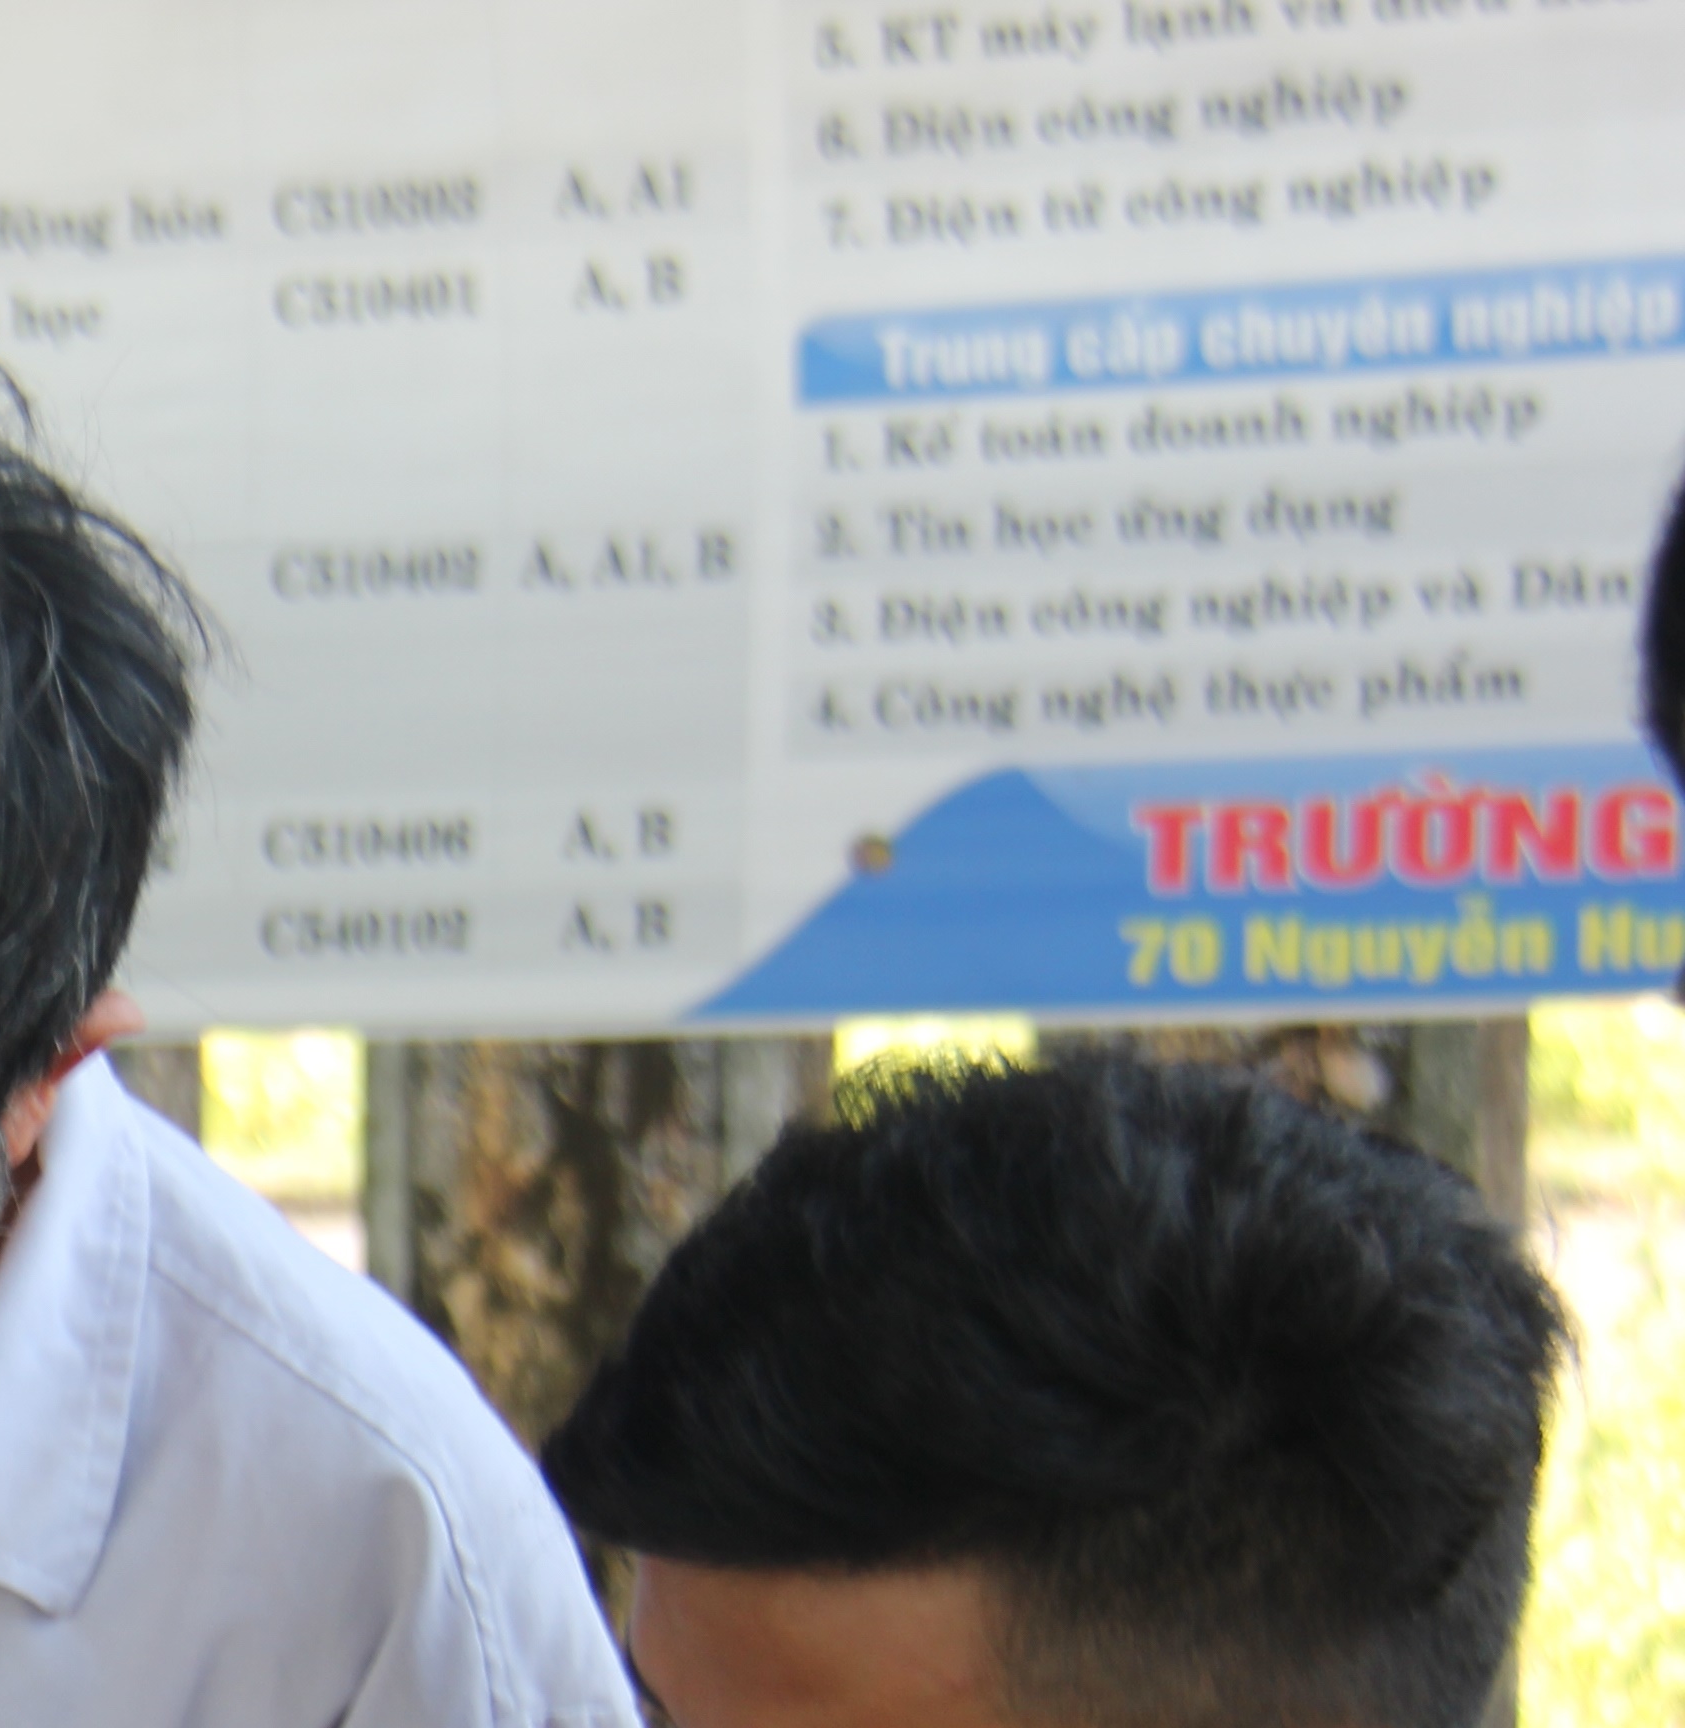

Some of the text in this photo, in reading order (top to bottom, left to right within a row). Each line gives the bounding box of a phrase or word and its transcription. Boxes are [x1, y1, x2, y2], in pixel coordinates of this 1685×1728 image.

[877, 274, 1681, 394] Trung cấp chuyên nghiệp
[1137, 768, 1683, 898] TRƯỜNG
[1121, 890, 1685, 988] 70 Nguyễn Hu
